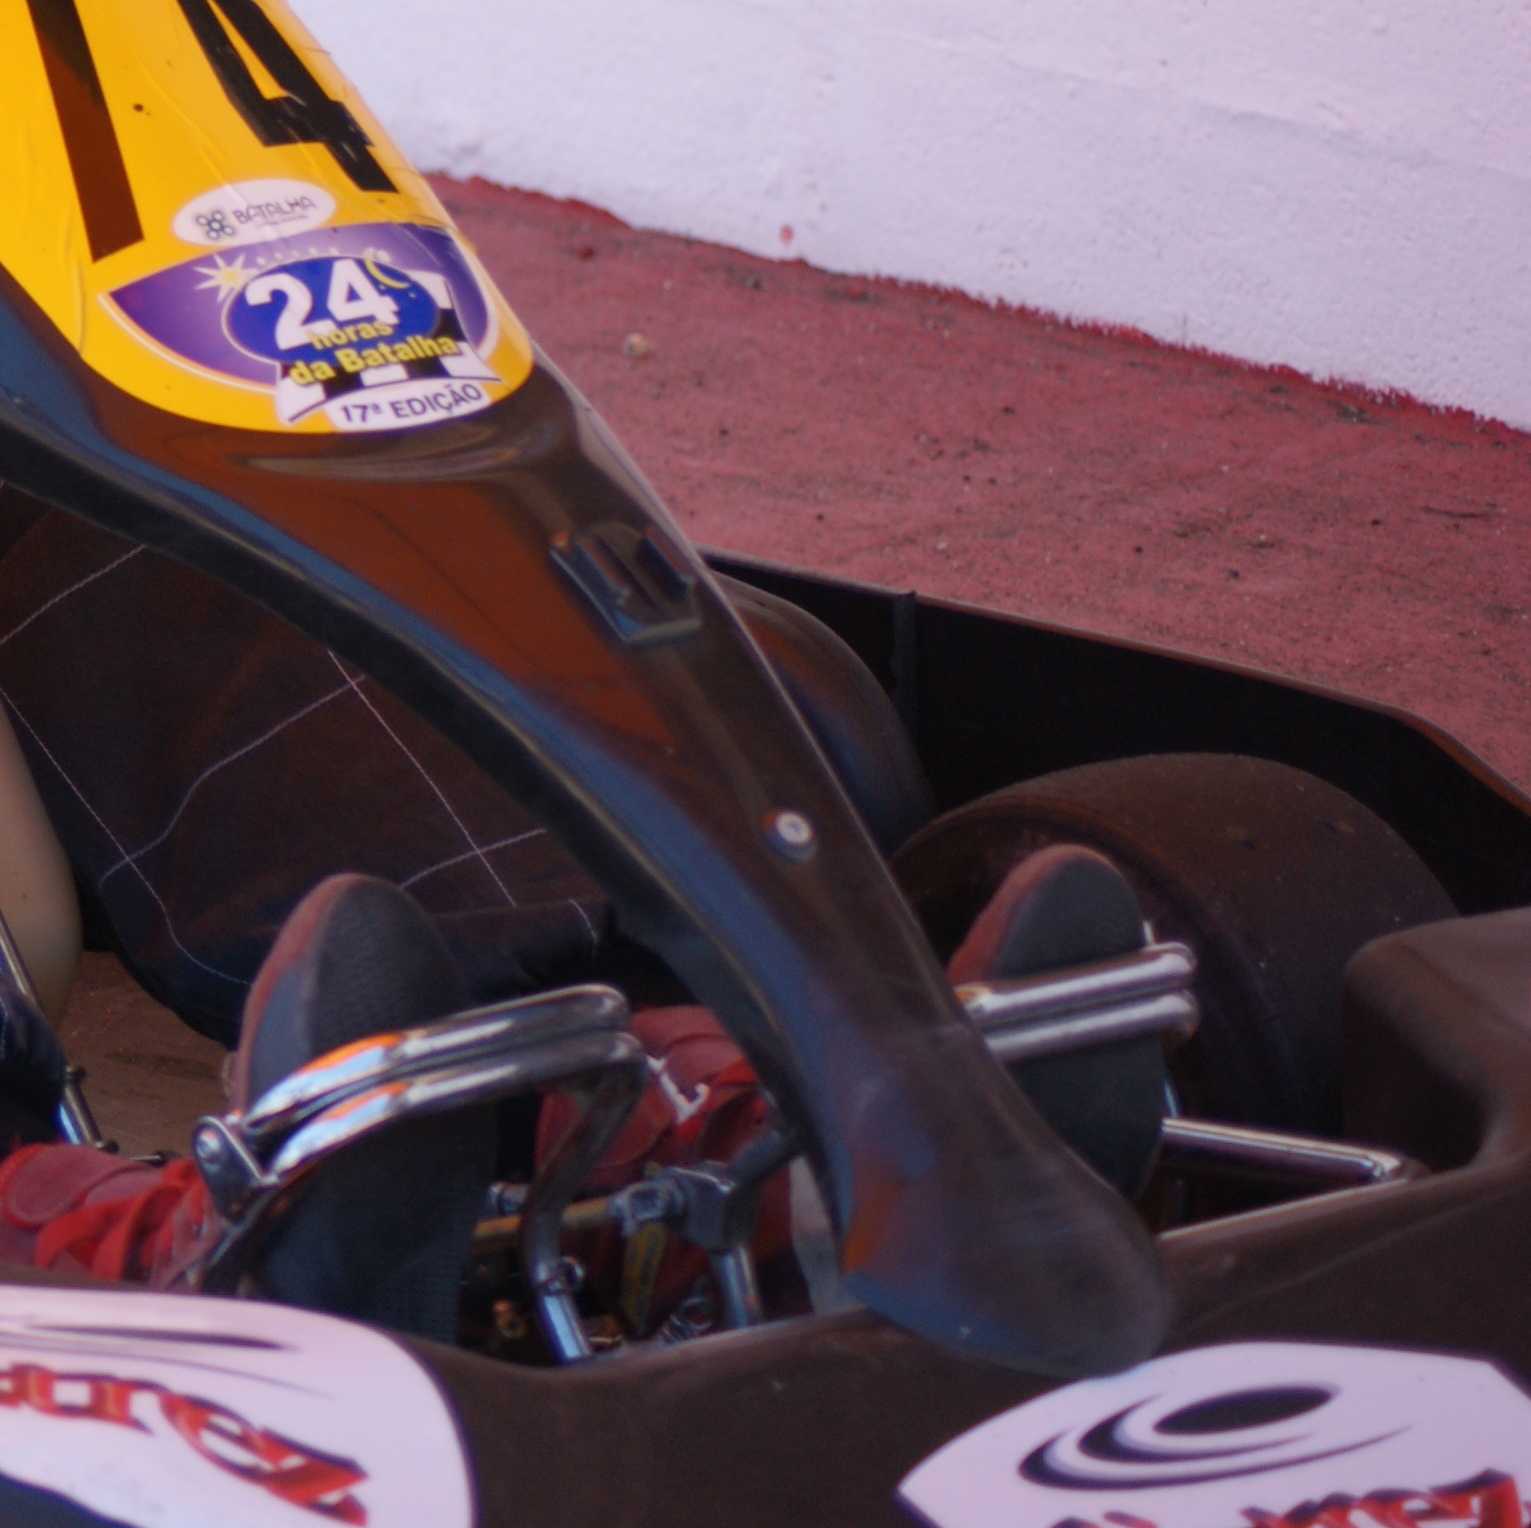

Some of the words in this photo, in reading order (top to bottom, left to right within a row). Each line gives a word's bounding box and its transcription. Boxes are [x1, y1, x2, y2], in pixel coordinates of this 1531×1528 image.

[232, 195, 316, 224] BATALHA
[245, 258, 399, 350] 24
[305, 321, 394, 350] horas
[288, 359, 336, 385] da
[335, 335, 459, 373] Batalha
[388, 383, 482, 420] EDIÇÃO
